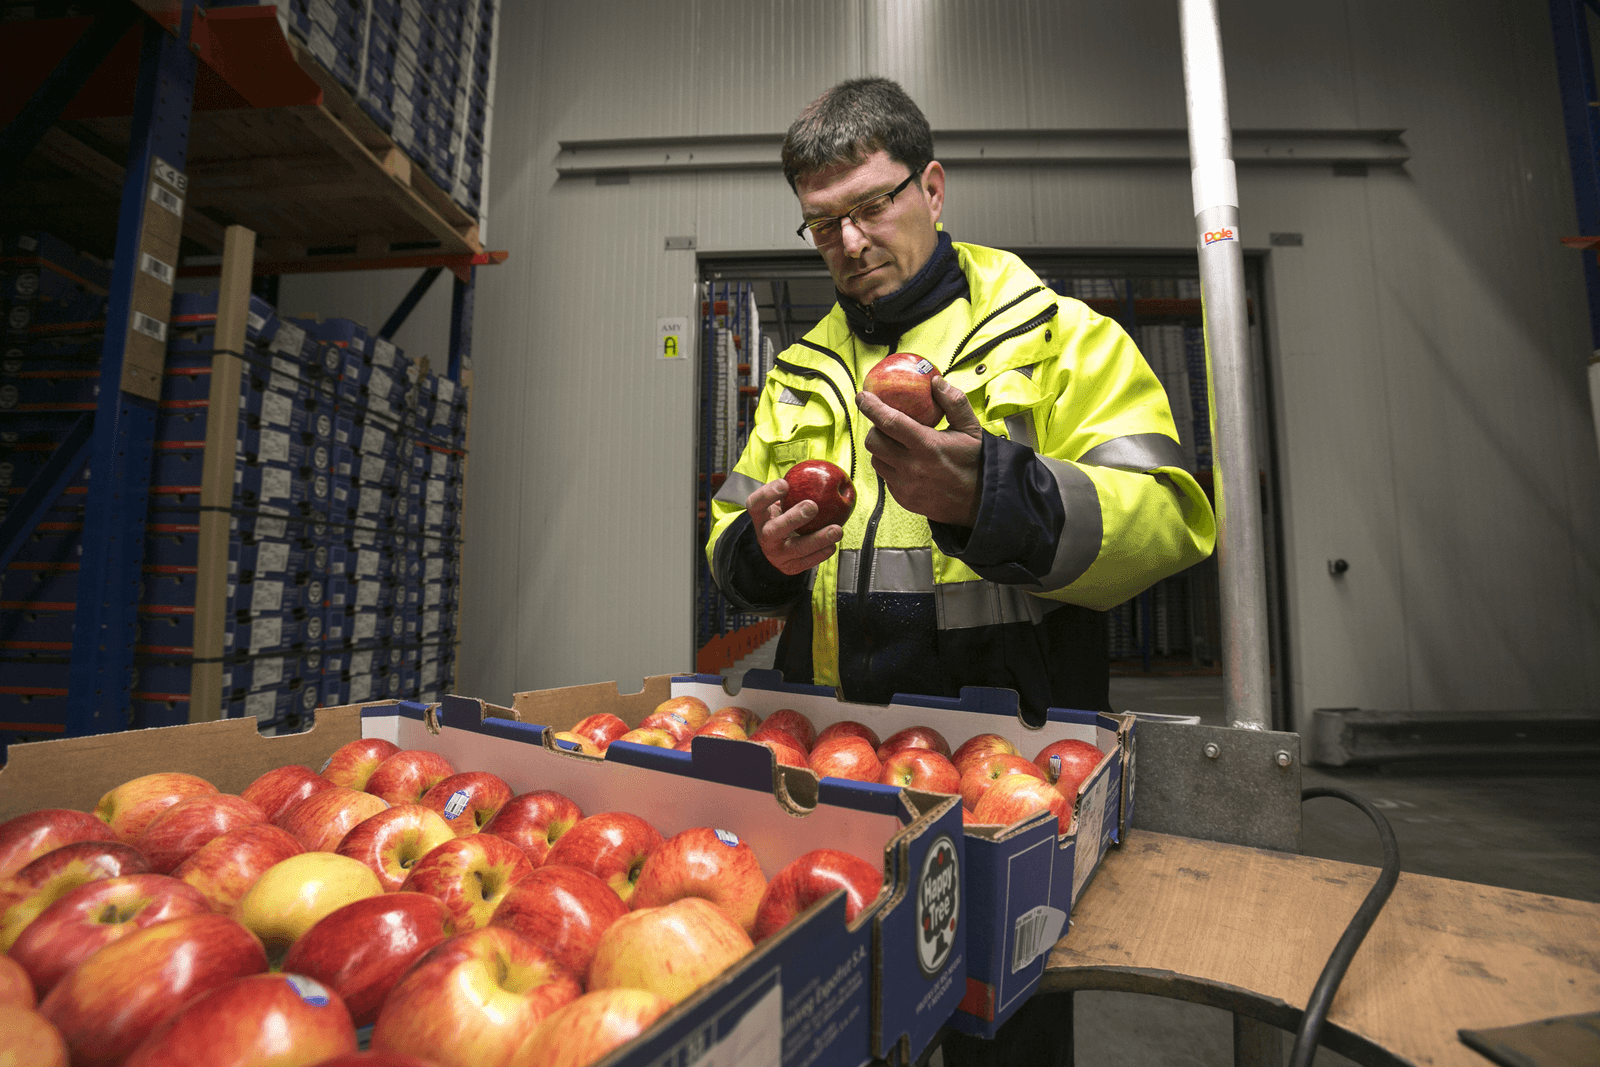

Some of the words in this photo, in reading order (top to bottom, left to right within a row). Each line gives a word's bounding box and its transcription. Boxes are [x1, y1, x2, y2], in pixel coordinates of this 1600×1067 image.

[1204, 228, 1233, 243] Dole
[661, 323, 681, 332] AMY
[664, 336, 676, 355] A
[924, 863, 953, 907] Happy
[929, 896, 950, 931] Tree
